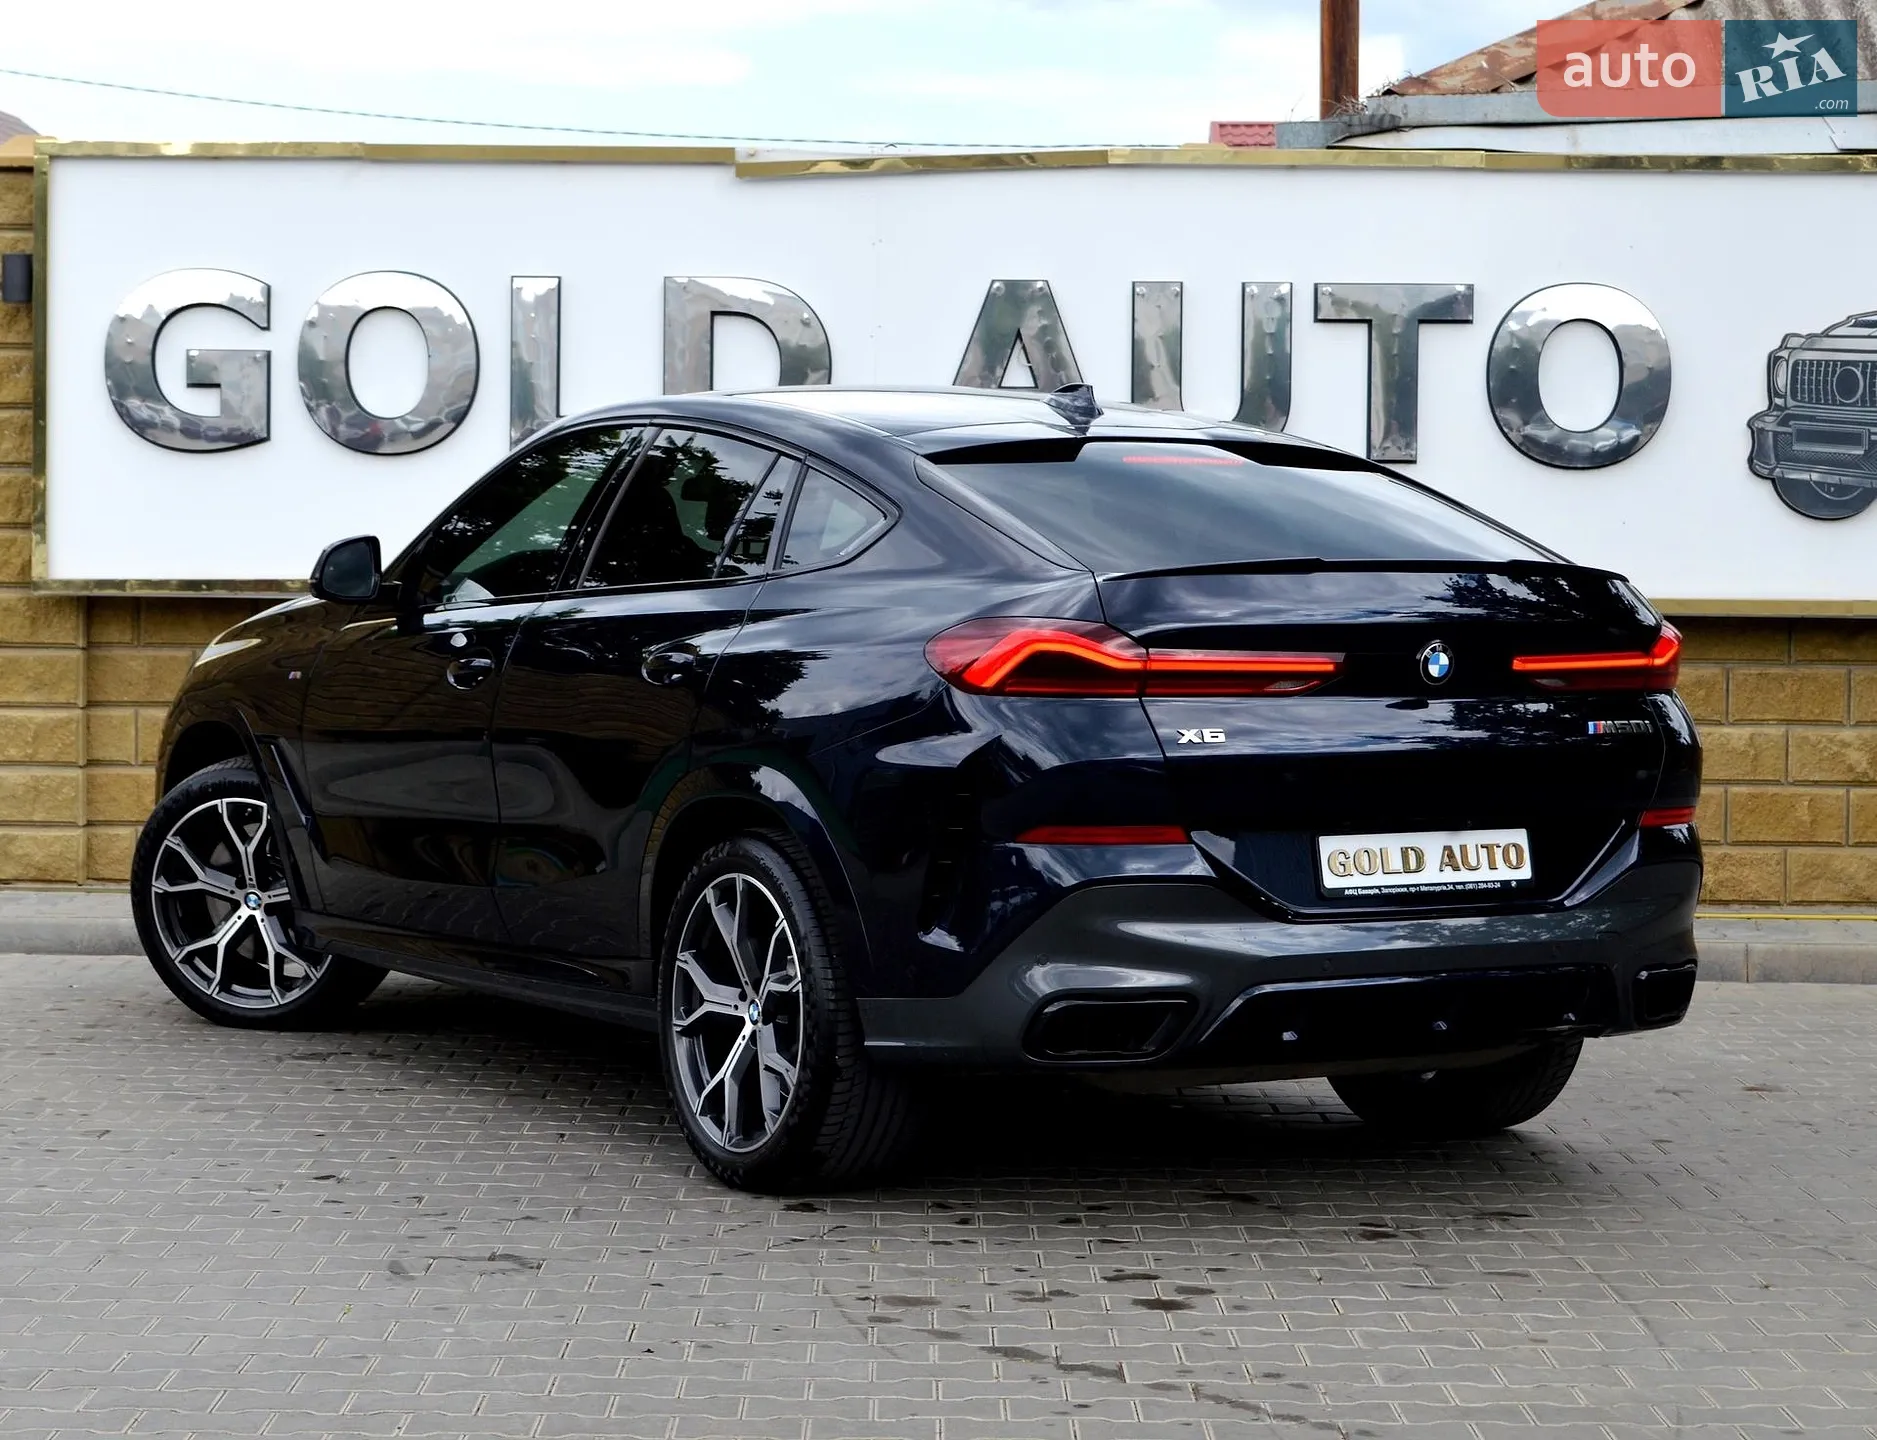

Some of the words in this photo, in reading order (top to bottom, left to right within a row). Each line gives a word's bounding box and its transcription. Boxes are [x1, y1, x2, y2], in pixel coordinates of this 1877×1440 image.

[105, 268, 832, 456] GOLD
[953, 279, 1672, 469] AUTO
[1177, 728, 1227, 745] X6
[1327, 845, 1427, 877] GOLD
[1439, 842, 1526, 872] AUTO
